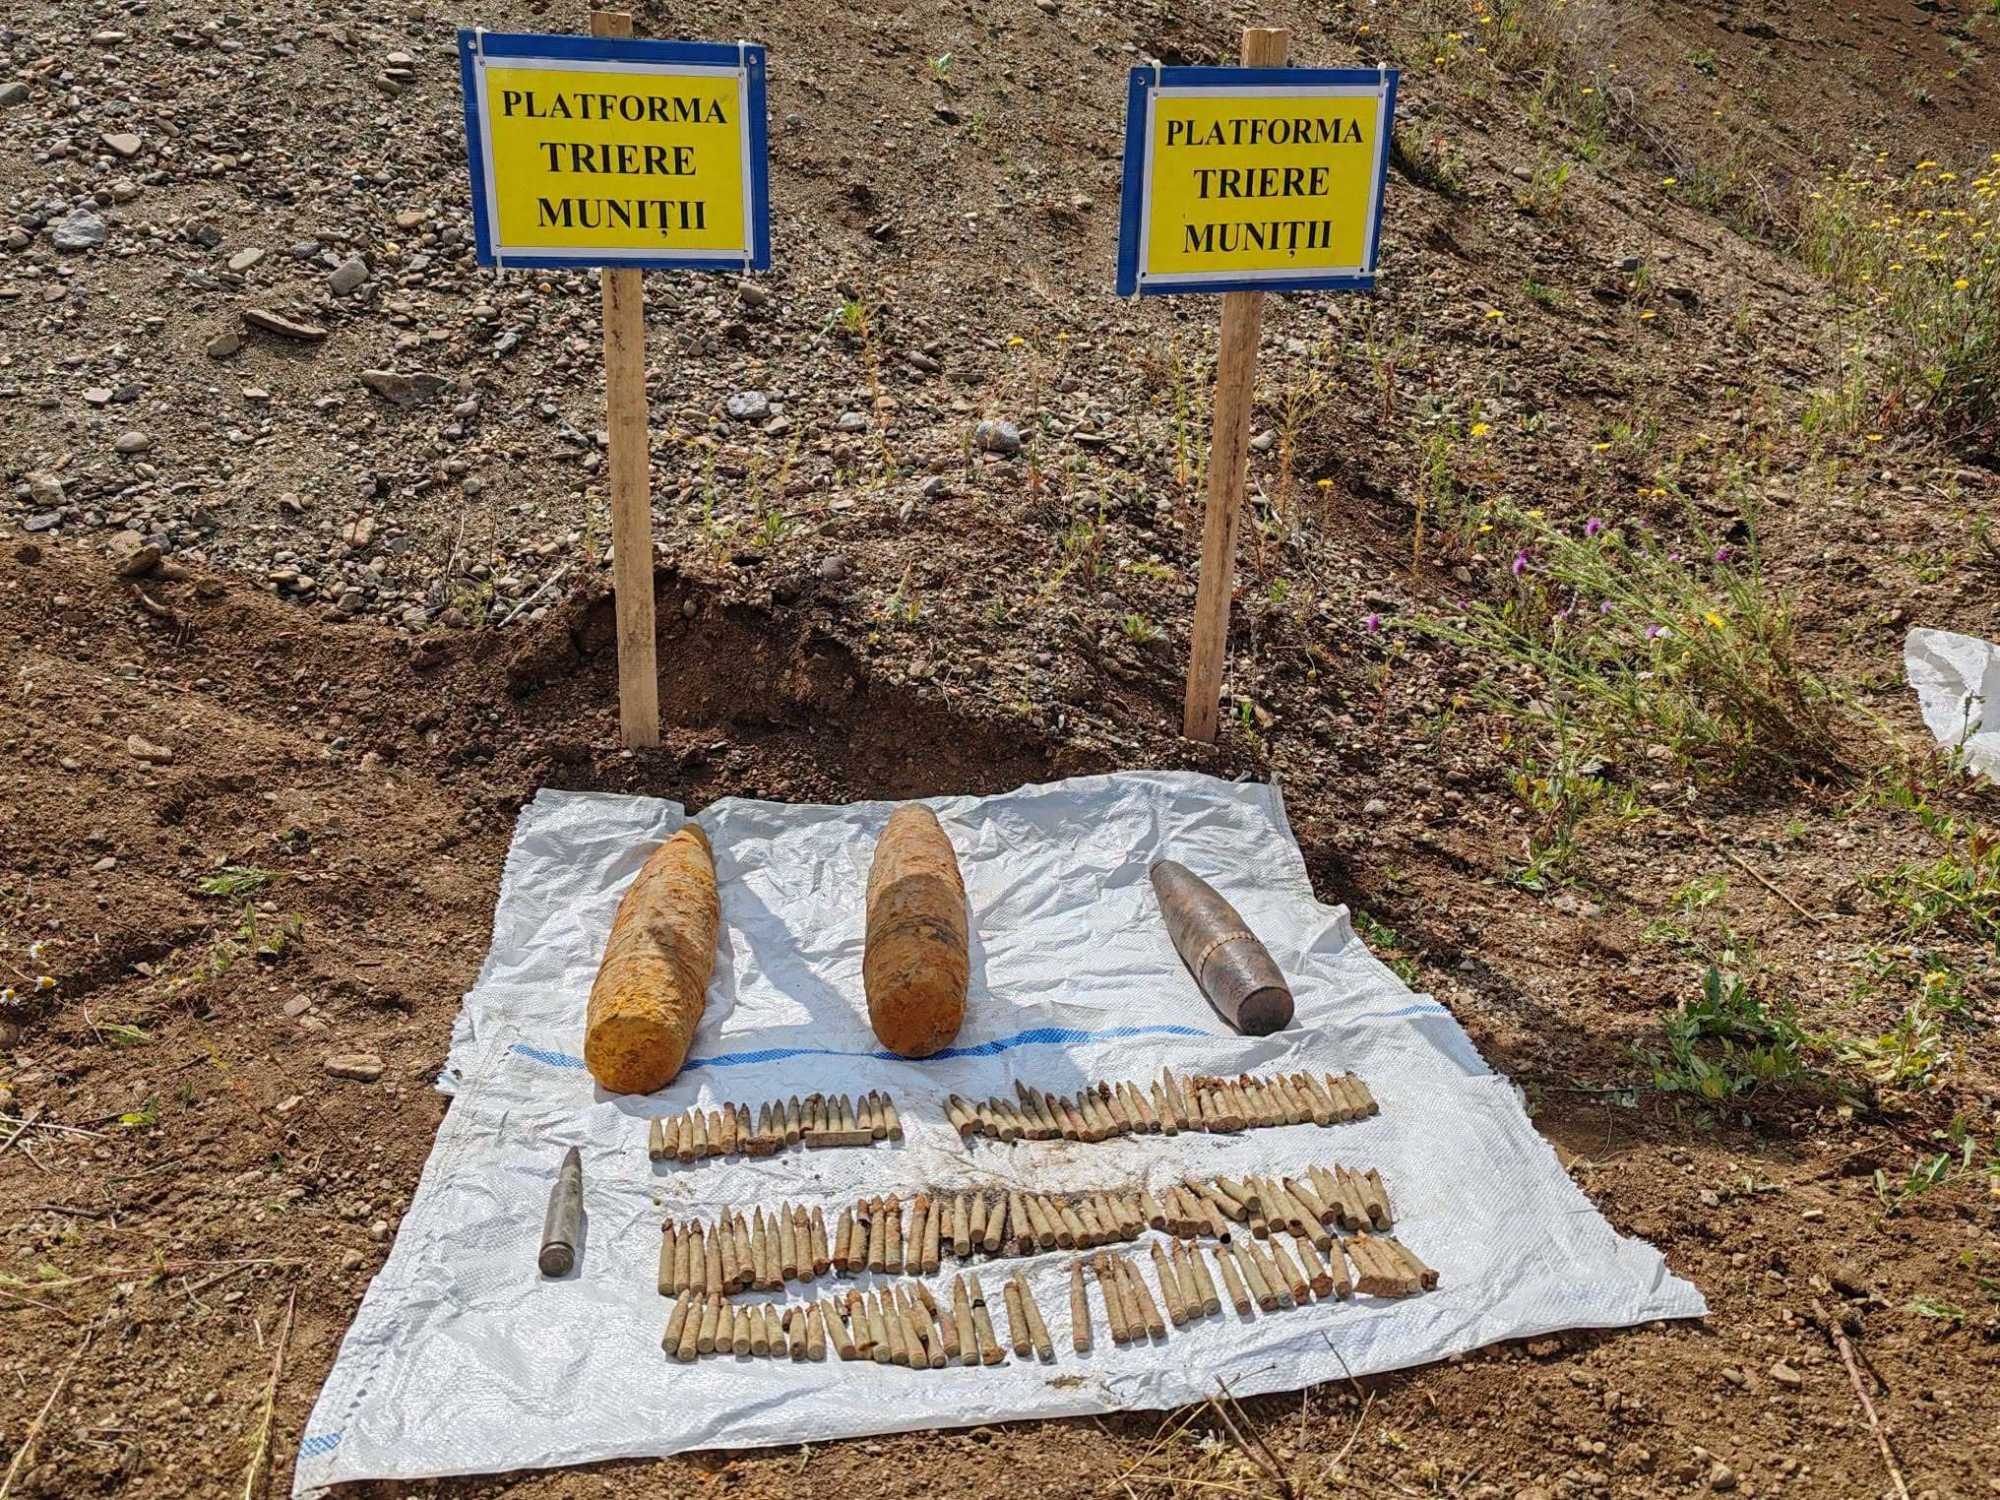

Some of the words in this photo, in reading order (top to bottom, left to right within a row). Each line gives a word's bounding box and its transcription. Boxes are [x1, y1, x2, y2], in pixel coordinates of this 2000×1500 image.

[502, 90, 728, 124] PLATFORMA
[1166, 118, 1364, 146] PLATFORMA
[539, 142, 696, 176] TRIERE
[1193, 166, 1330, 199] TRIERE
[537, 197, 707, 238] MUNIȚII
[1182, 220, 1333, 258] MUNIȚII
